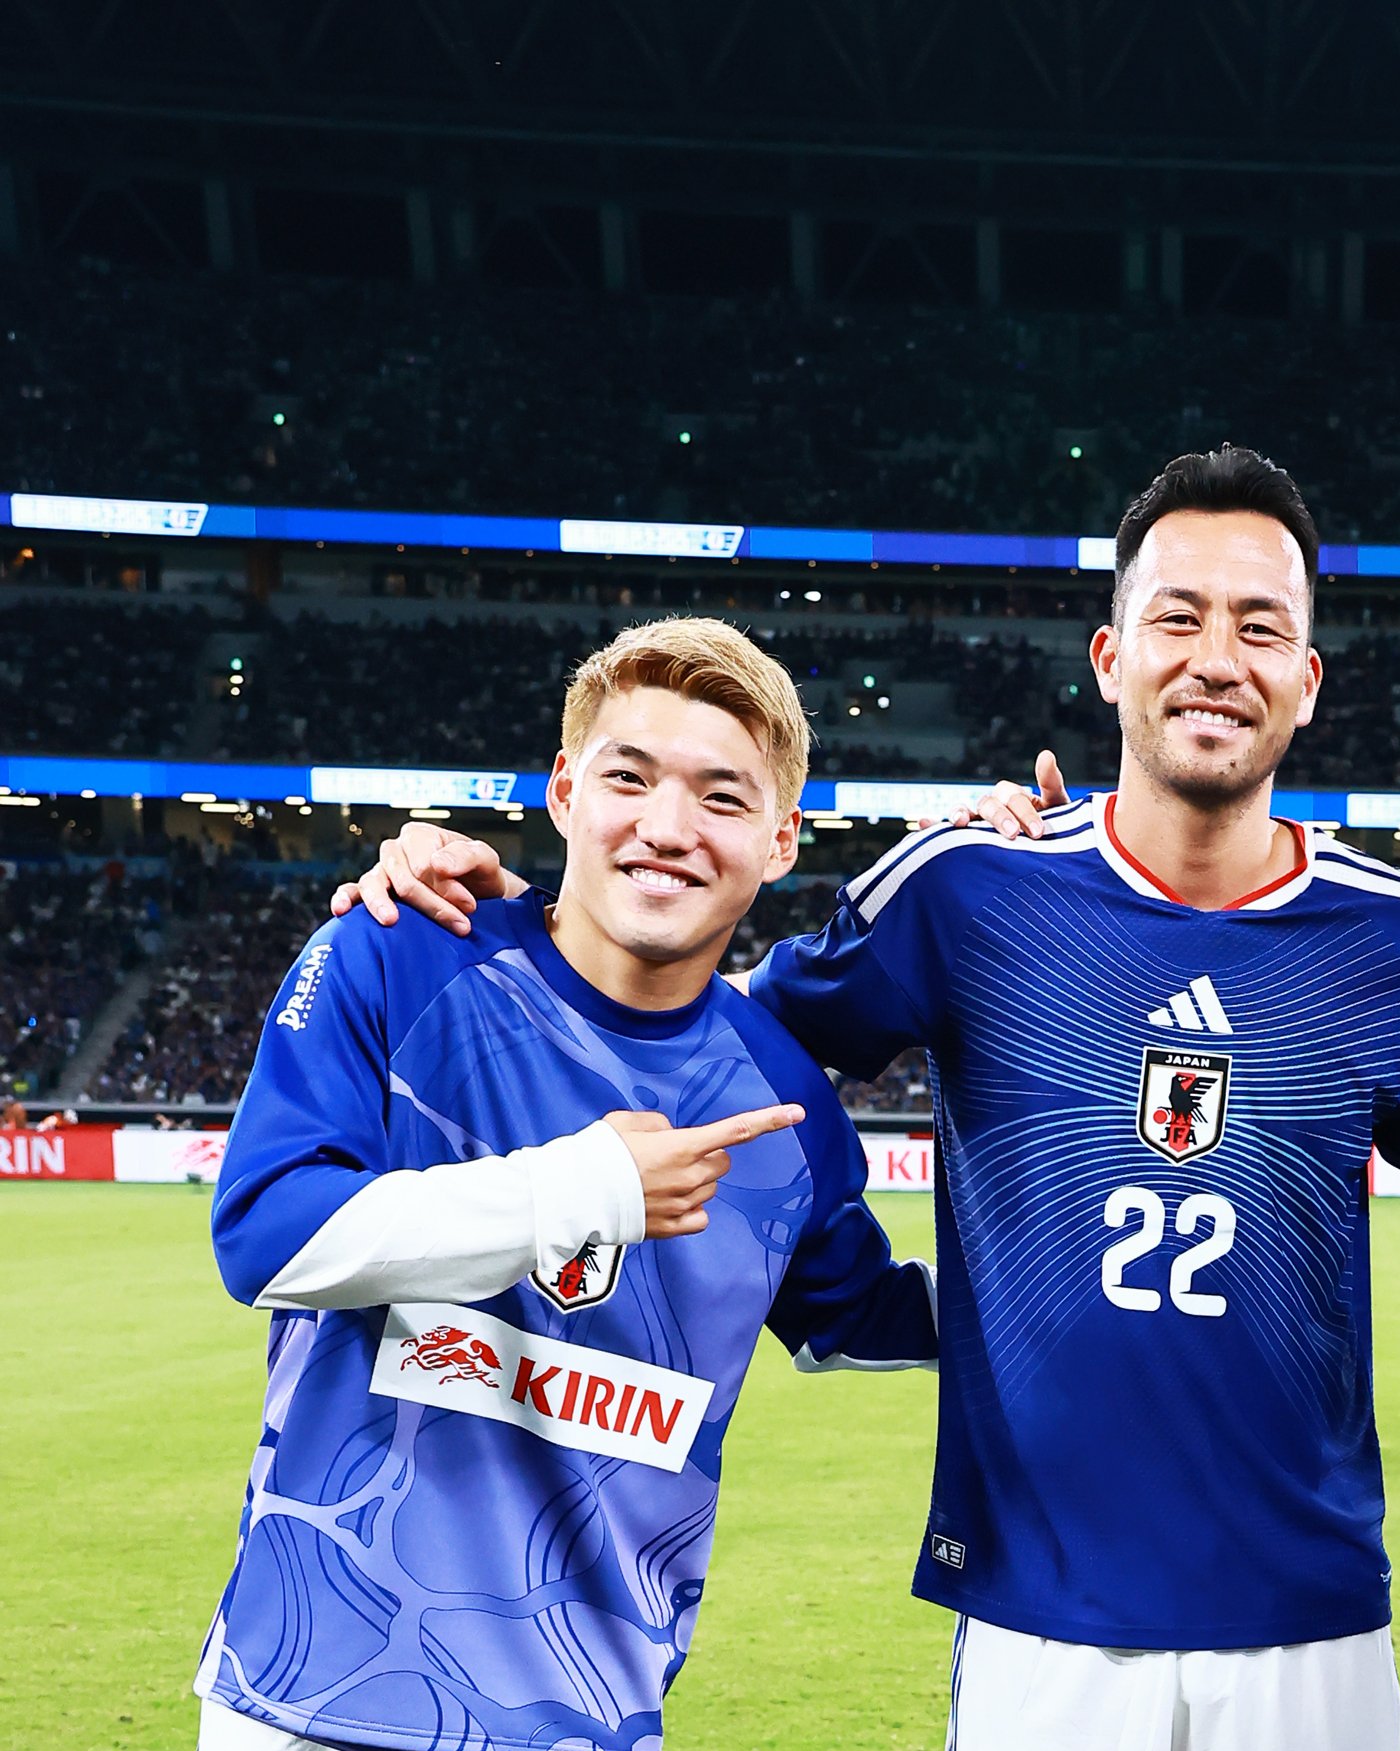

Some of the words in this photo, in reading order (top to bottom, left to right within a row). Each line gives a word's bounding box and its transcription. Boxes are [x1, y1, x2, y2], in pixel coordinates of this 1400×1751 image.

[276, 943, 333, 1031] DREAM
[1164, 1054, 1210, 1068] JAPAN
[1159, 1126, 1198, 1146] JFA
[1101, 1186, 1238, 1318] 22
[549, 1268, 589, 1295] JFA
[510, 1355, 685, 1445] KIRIN
